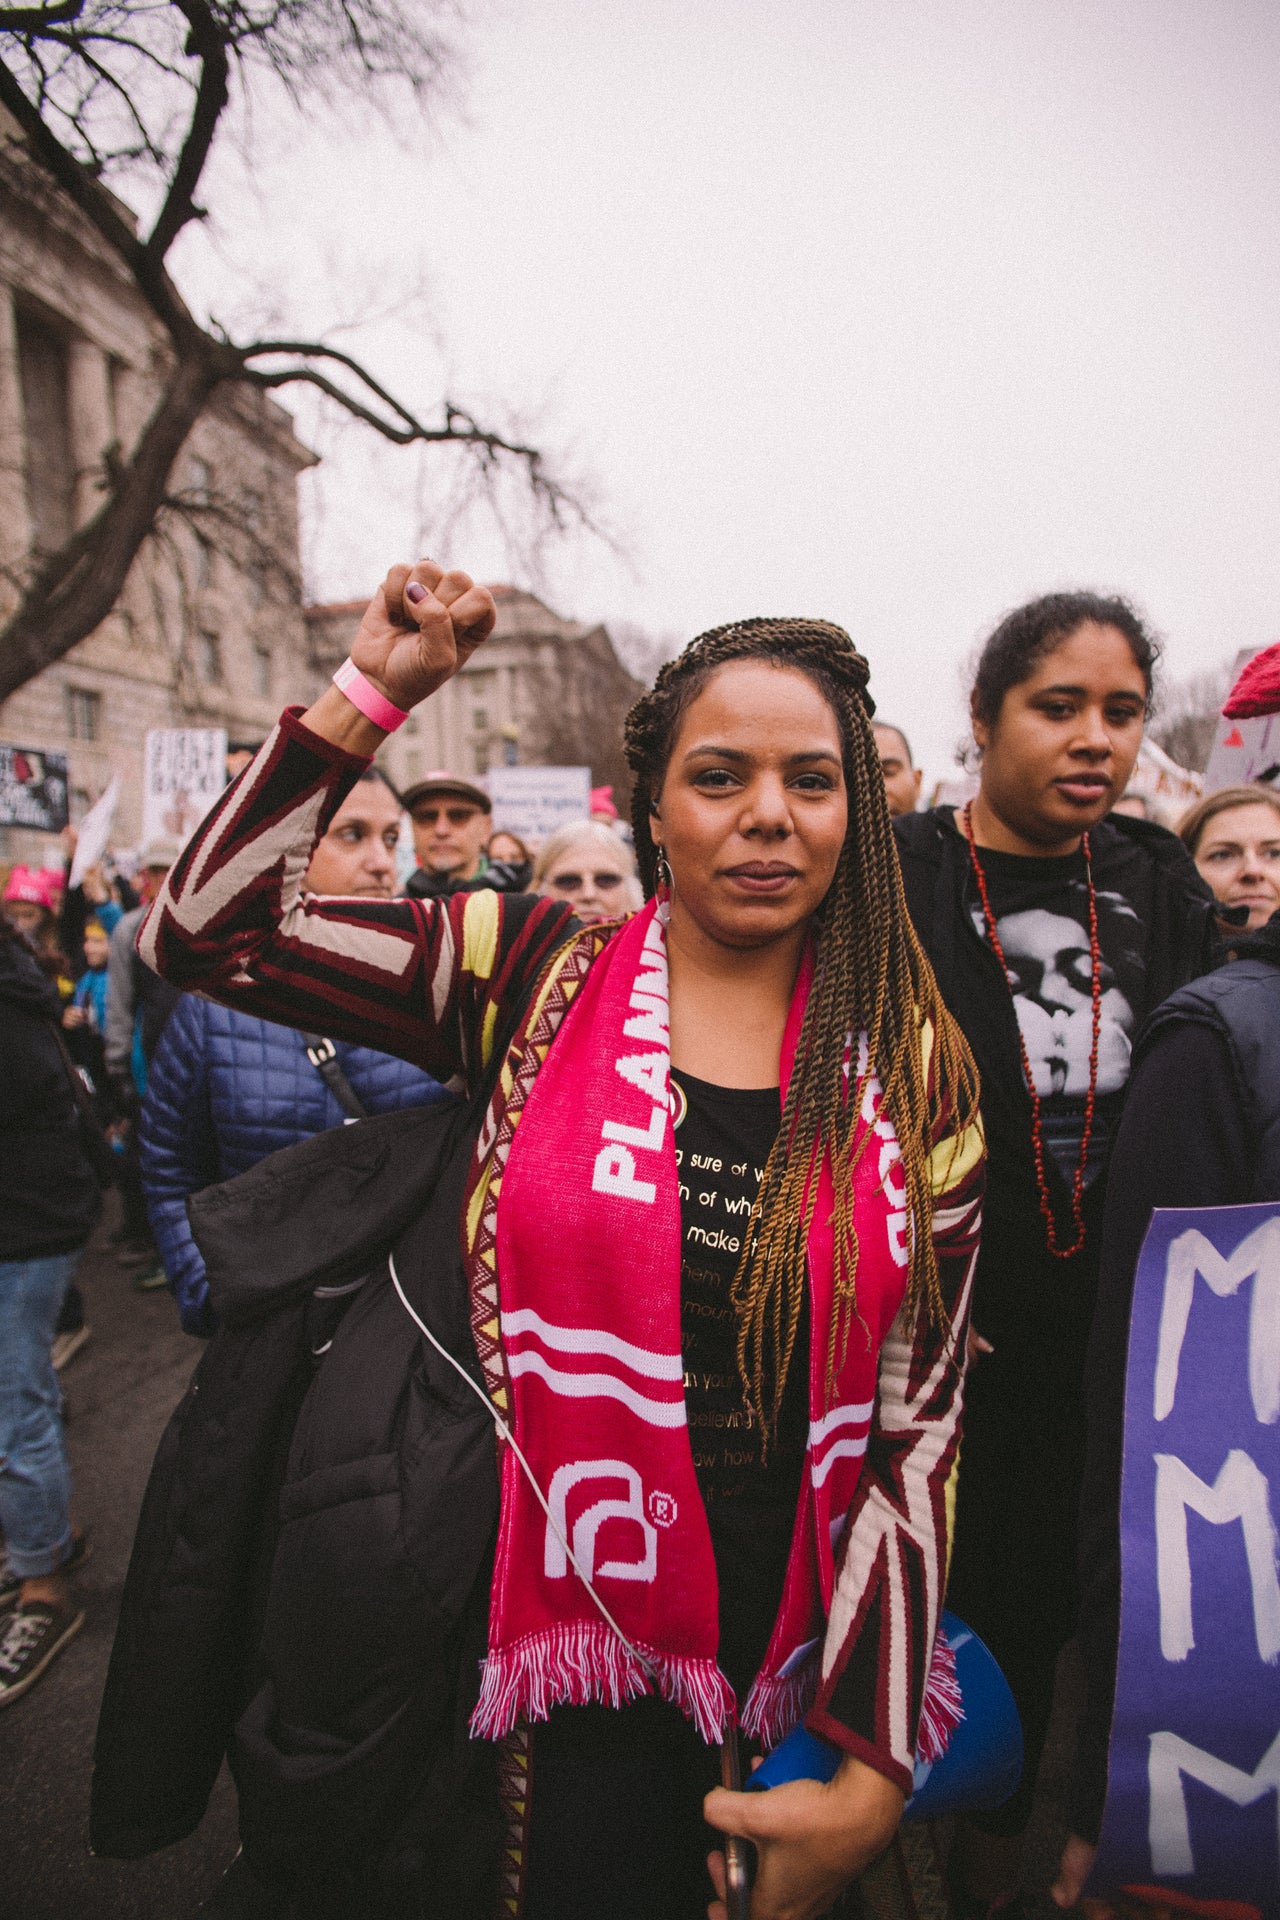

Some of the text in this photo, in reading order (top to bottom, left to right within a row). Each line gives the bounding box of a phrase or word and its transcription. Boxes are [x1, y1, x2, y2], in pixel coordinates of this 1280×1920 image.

[690, 1153, 723, 1173] sure
[731, 1163, 748, 1177] of
[699, 1191, 718, 1208] of
[725, 1196, 763, 1219] wha
[687, 1226, 740, 1253] make
[682, 1258, 721, 1287] hem
[693, 1448, 754, 1468] ow how
